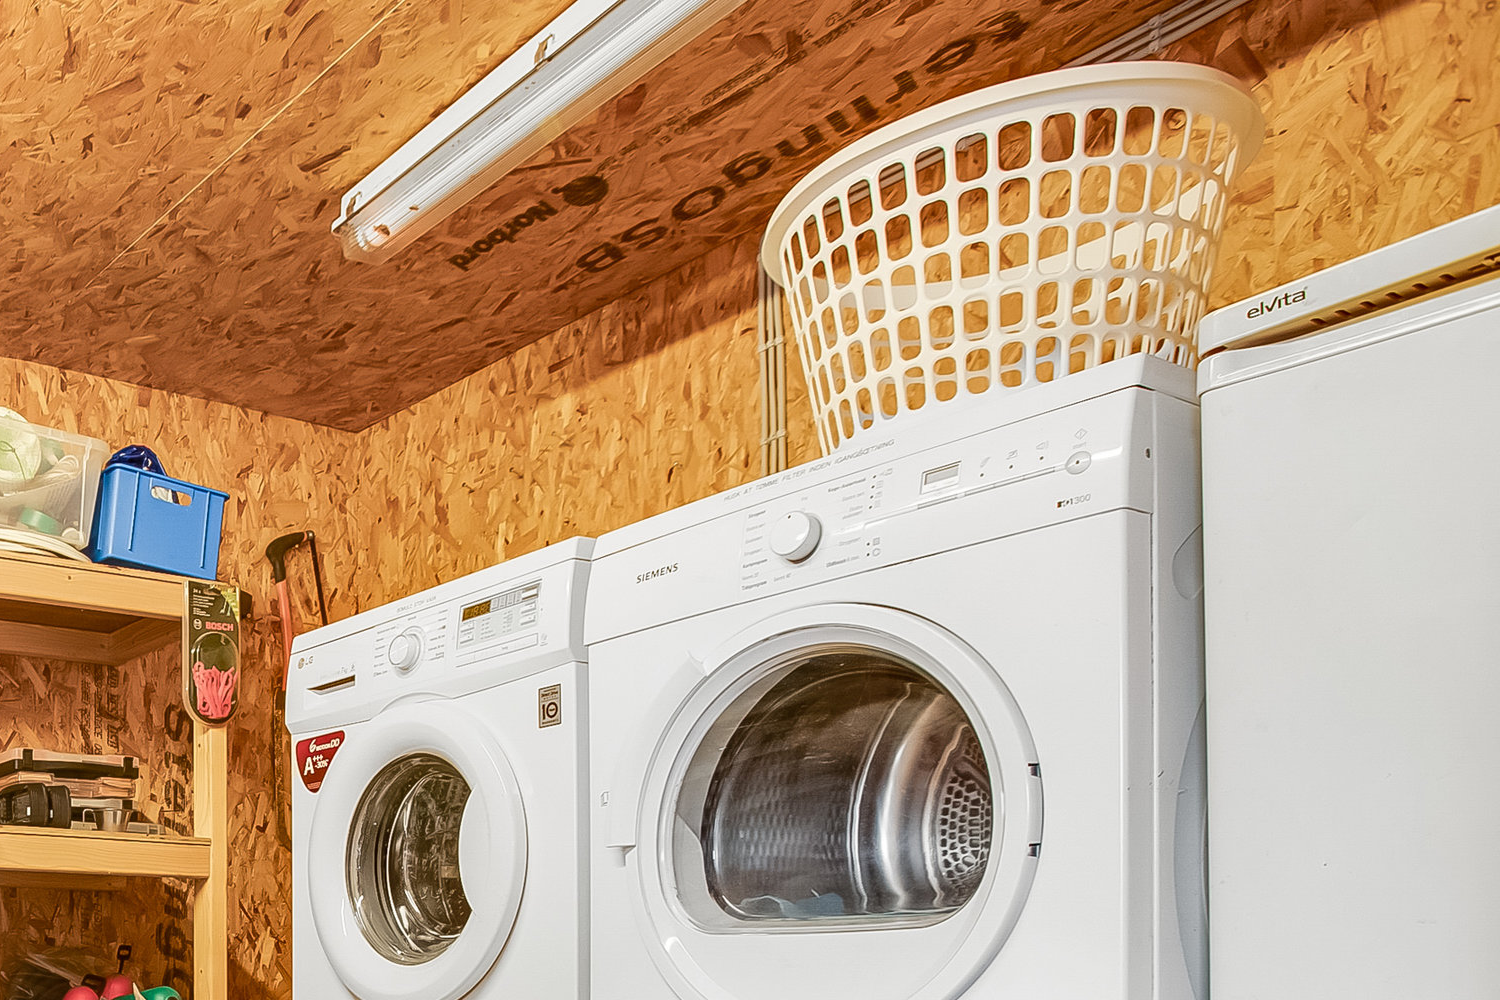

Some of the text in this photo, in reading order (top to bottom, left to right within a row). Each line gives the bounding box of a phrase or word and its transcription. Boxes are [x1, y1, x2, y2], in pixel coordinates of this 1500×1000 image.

[449, 199, 557, 272] Norbord
[1246, 288, 1306, 320] elvita
[636, 562, 679, 584] SIEMENS
[205, 621, 234, 631] BOSCH
